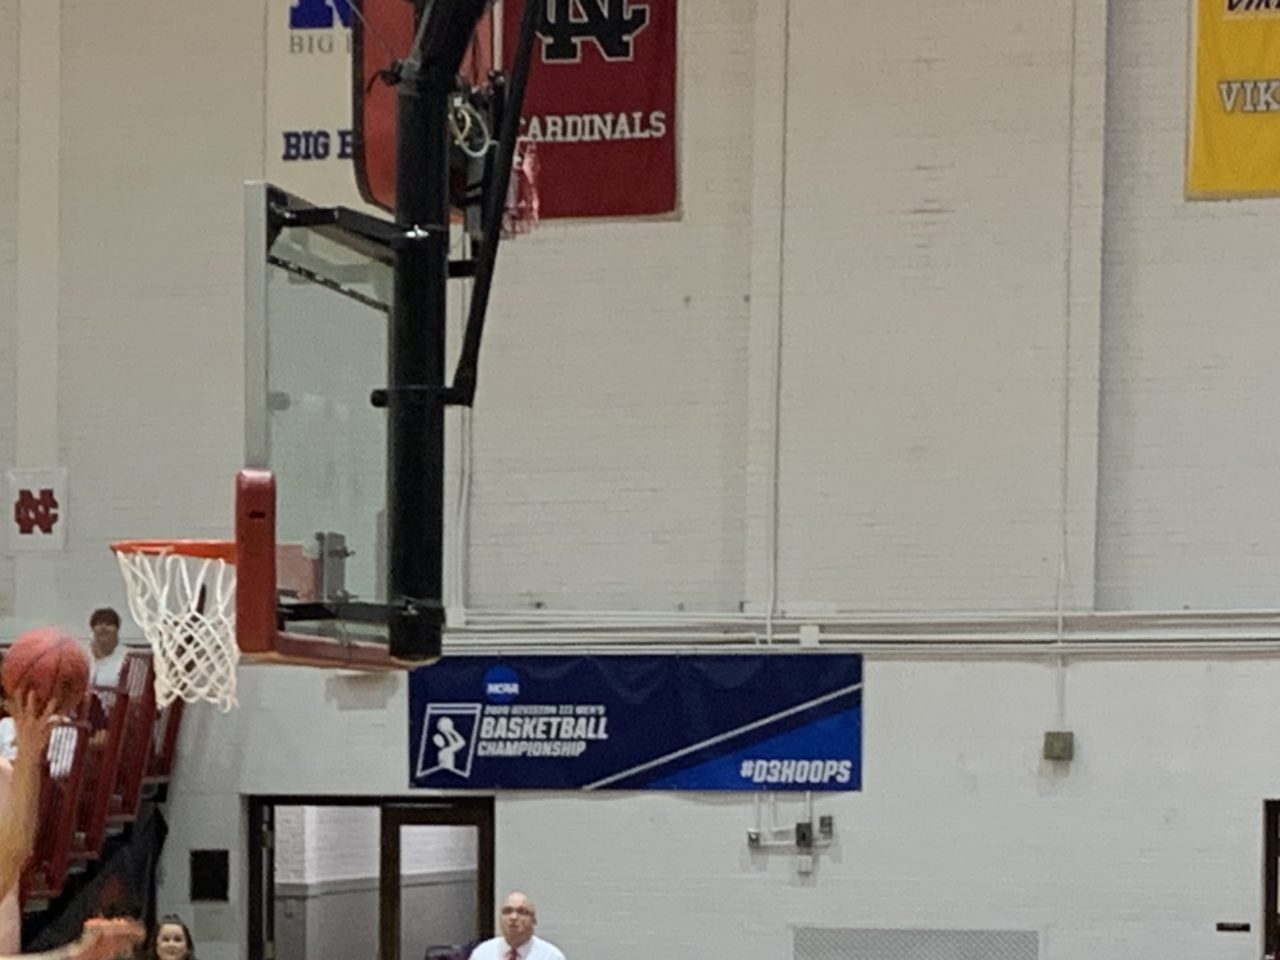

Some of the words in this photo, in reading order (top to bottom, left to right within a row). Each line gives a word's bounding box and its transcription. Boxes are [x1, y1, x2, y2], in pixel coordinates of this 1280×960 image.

[282, 130, 331, 161] BIG
[480, 716, 609, 740] BASKETBALL
[476, 740, 588, 757] CHAMPIONSHIP
[739, 759, 853, 783] #D3HOOPS
